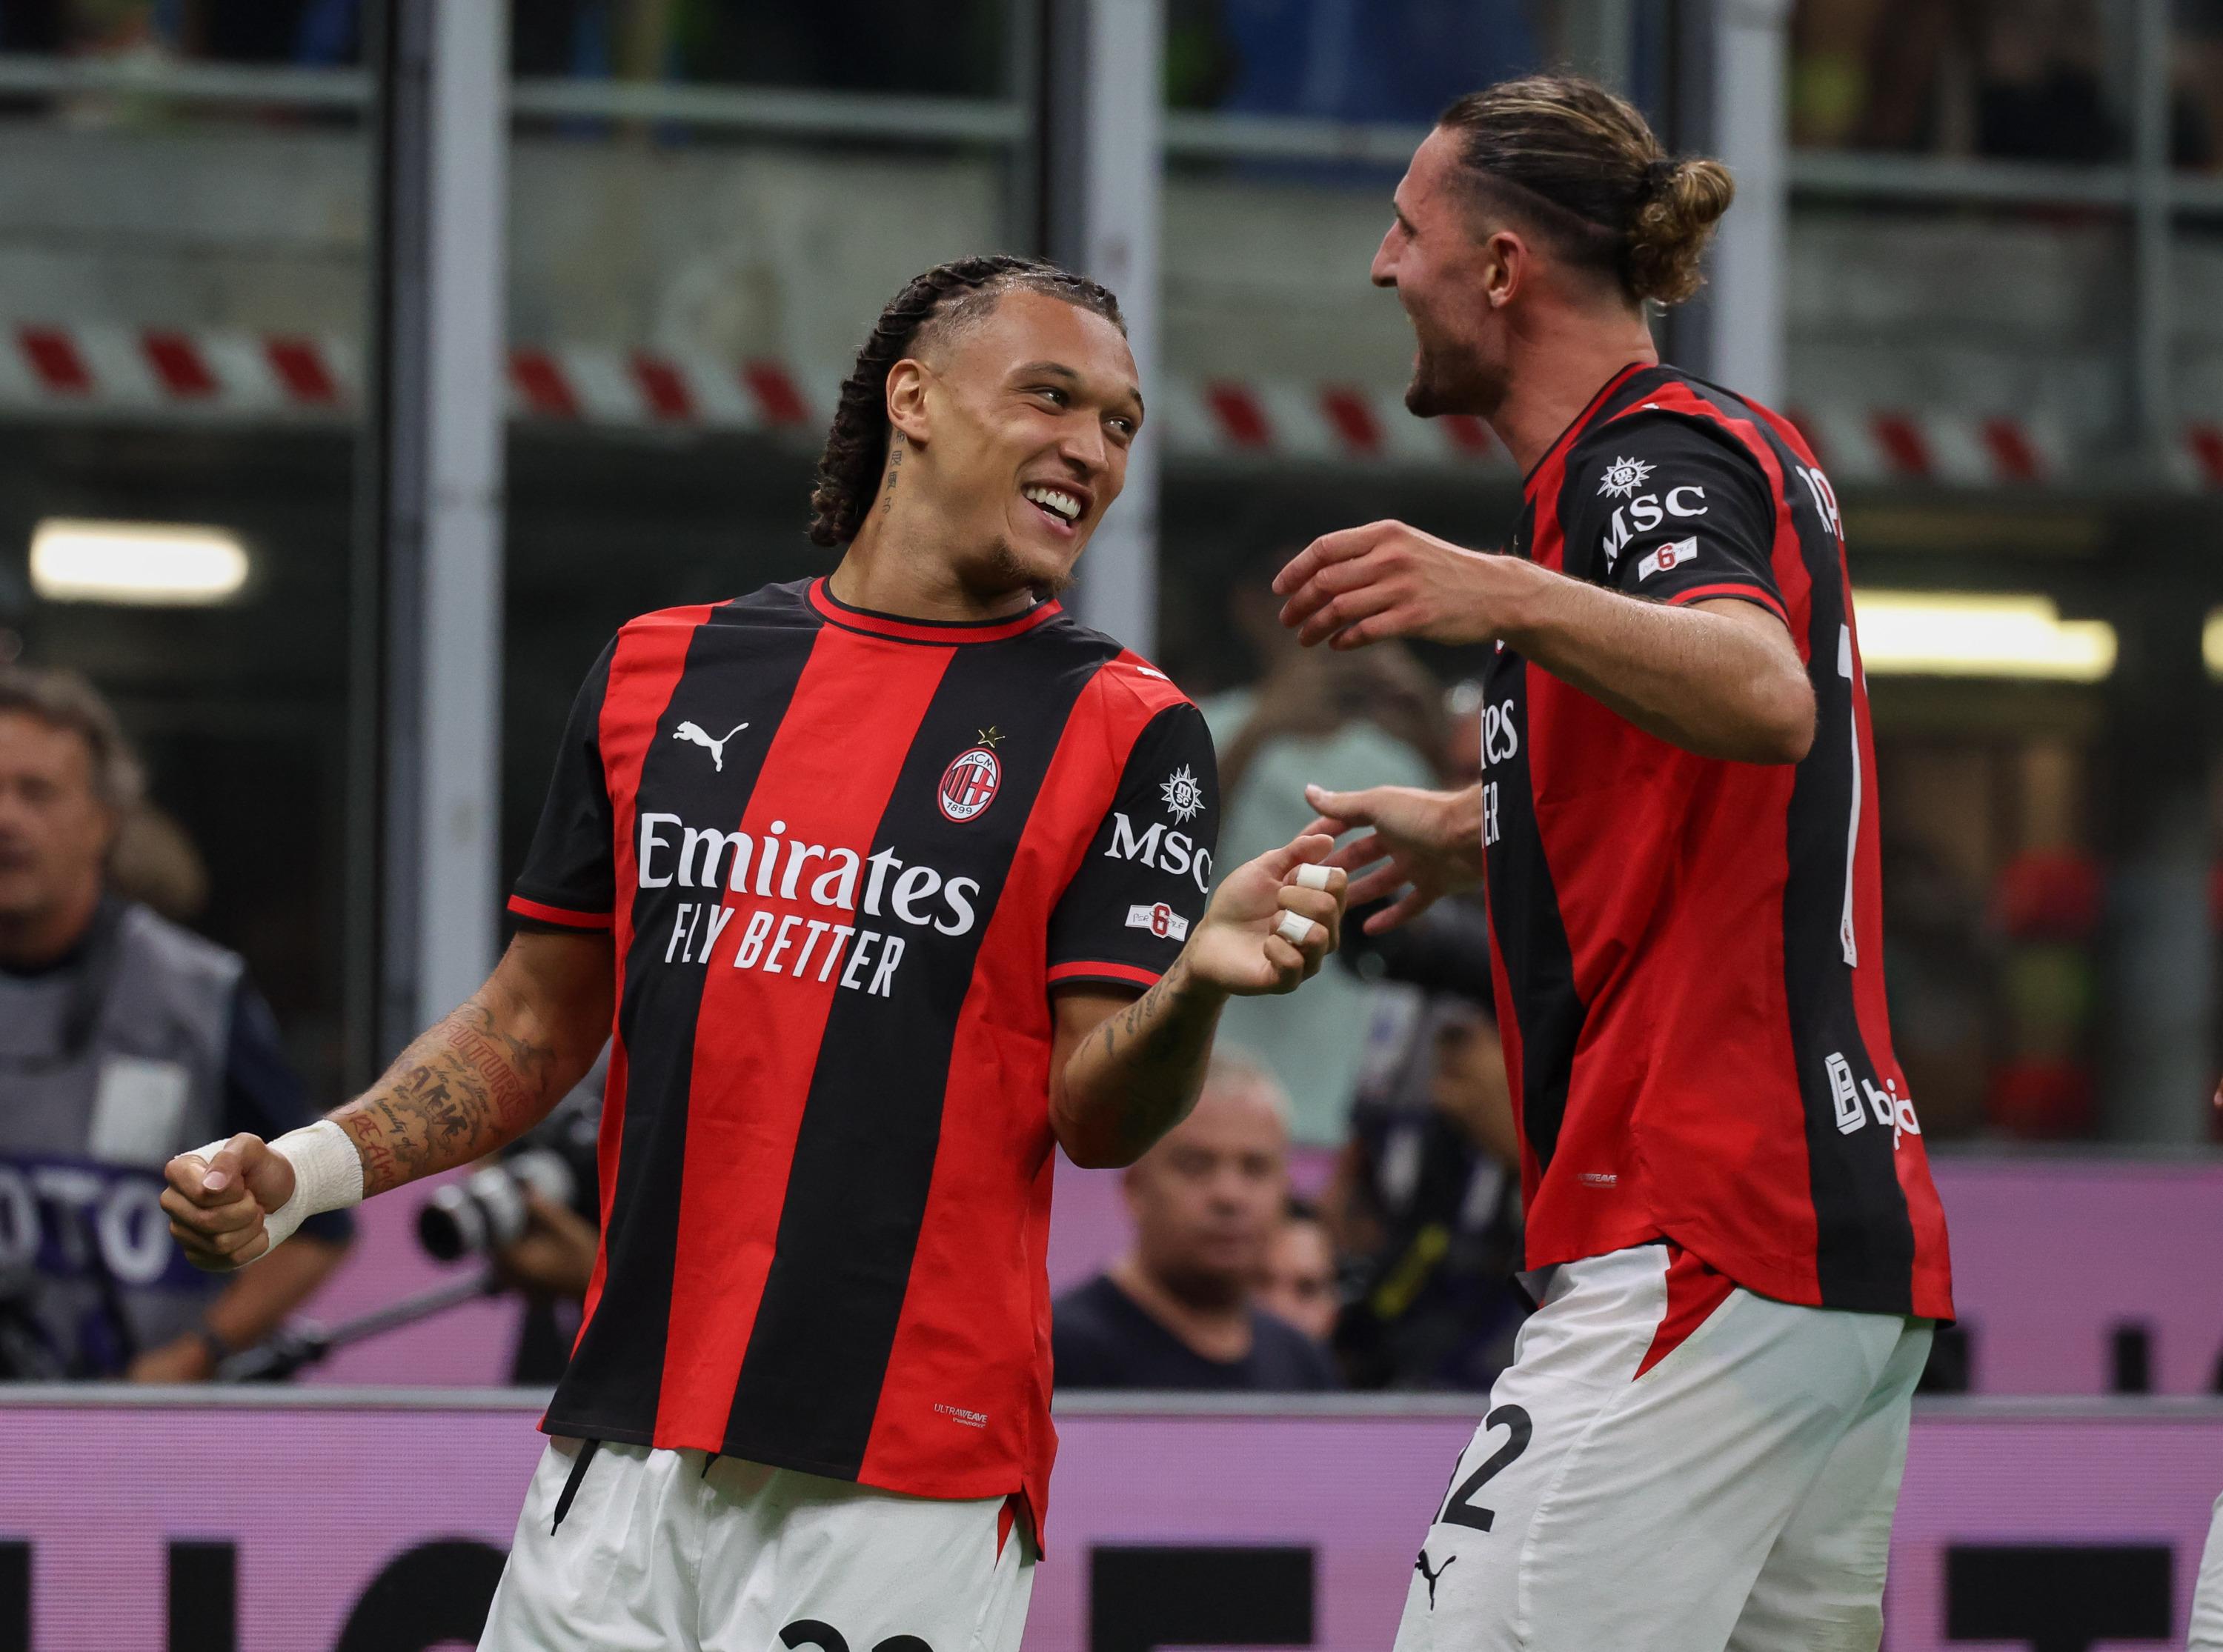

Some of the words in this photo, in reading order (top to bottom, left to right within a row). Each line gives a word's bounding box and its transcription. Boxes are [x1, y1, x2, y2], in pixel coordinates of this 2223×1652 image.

[1603, 486, 1708, 575] MSC
[1657, 544, 1675, 569] 6
[962, 753, 993, 771] ACM
[947, 802, 972, 814] 1899
[639, 813, 980, 936] Emirates
[1152, 905, 1170, 936] 6
[665, 903, 736, 964] FLY
[734, 910, 906, 998] BETTER
[934, 1403, 988, 1423] ULTRAWEAVE
[1432, 1404, 1532, 1533] 2
